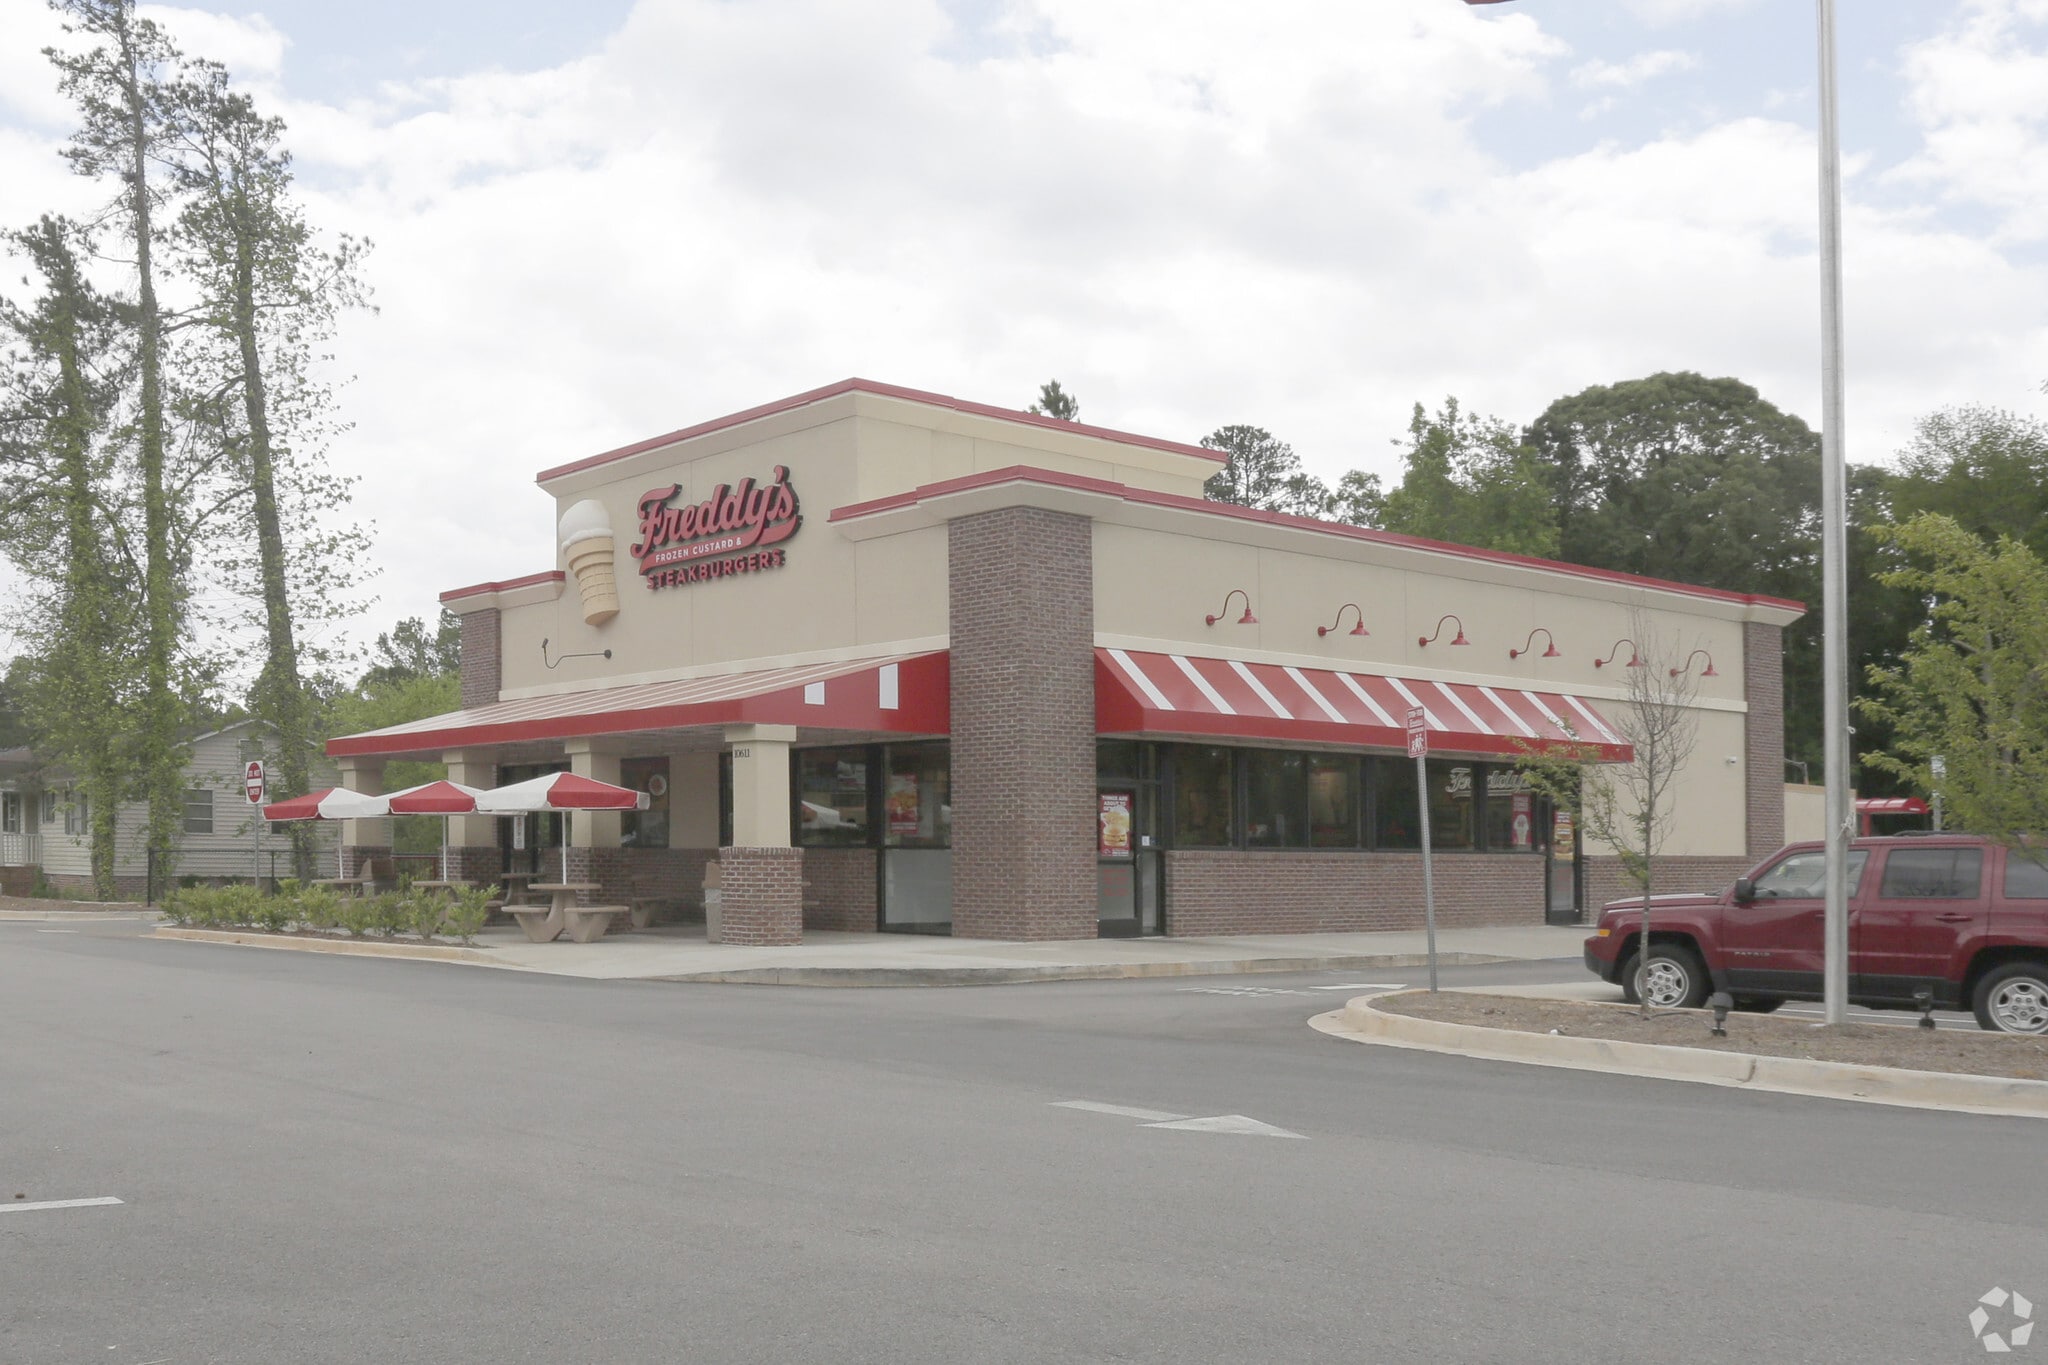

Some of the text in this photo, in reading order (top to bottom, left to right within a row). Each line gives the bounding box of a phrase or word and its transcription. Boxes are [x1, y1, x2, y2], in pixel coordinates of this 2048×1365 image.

[630, 465, 801, 559] Freddy's
[646, 548, 786, 590] STEAKBURGERS
[655, 537, 742, 563] FROZEN CUSTARD &
